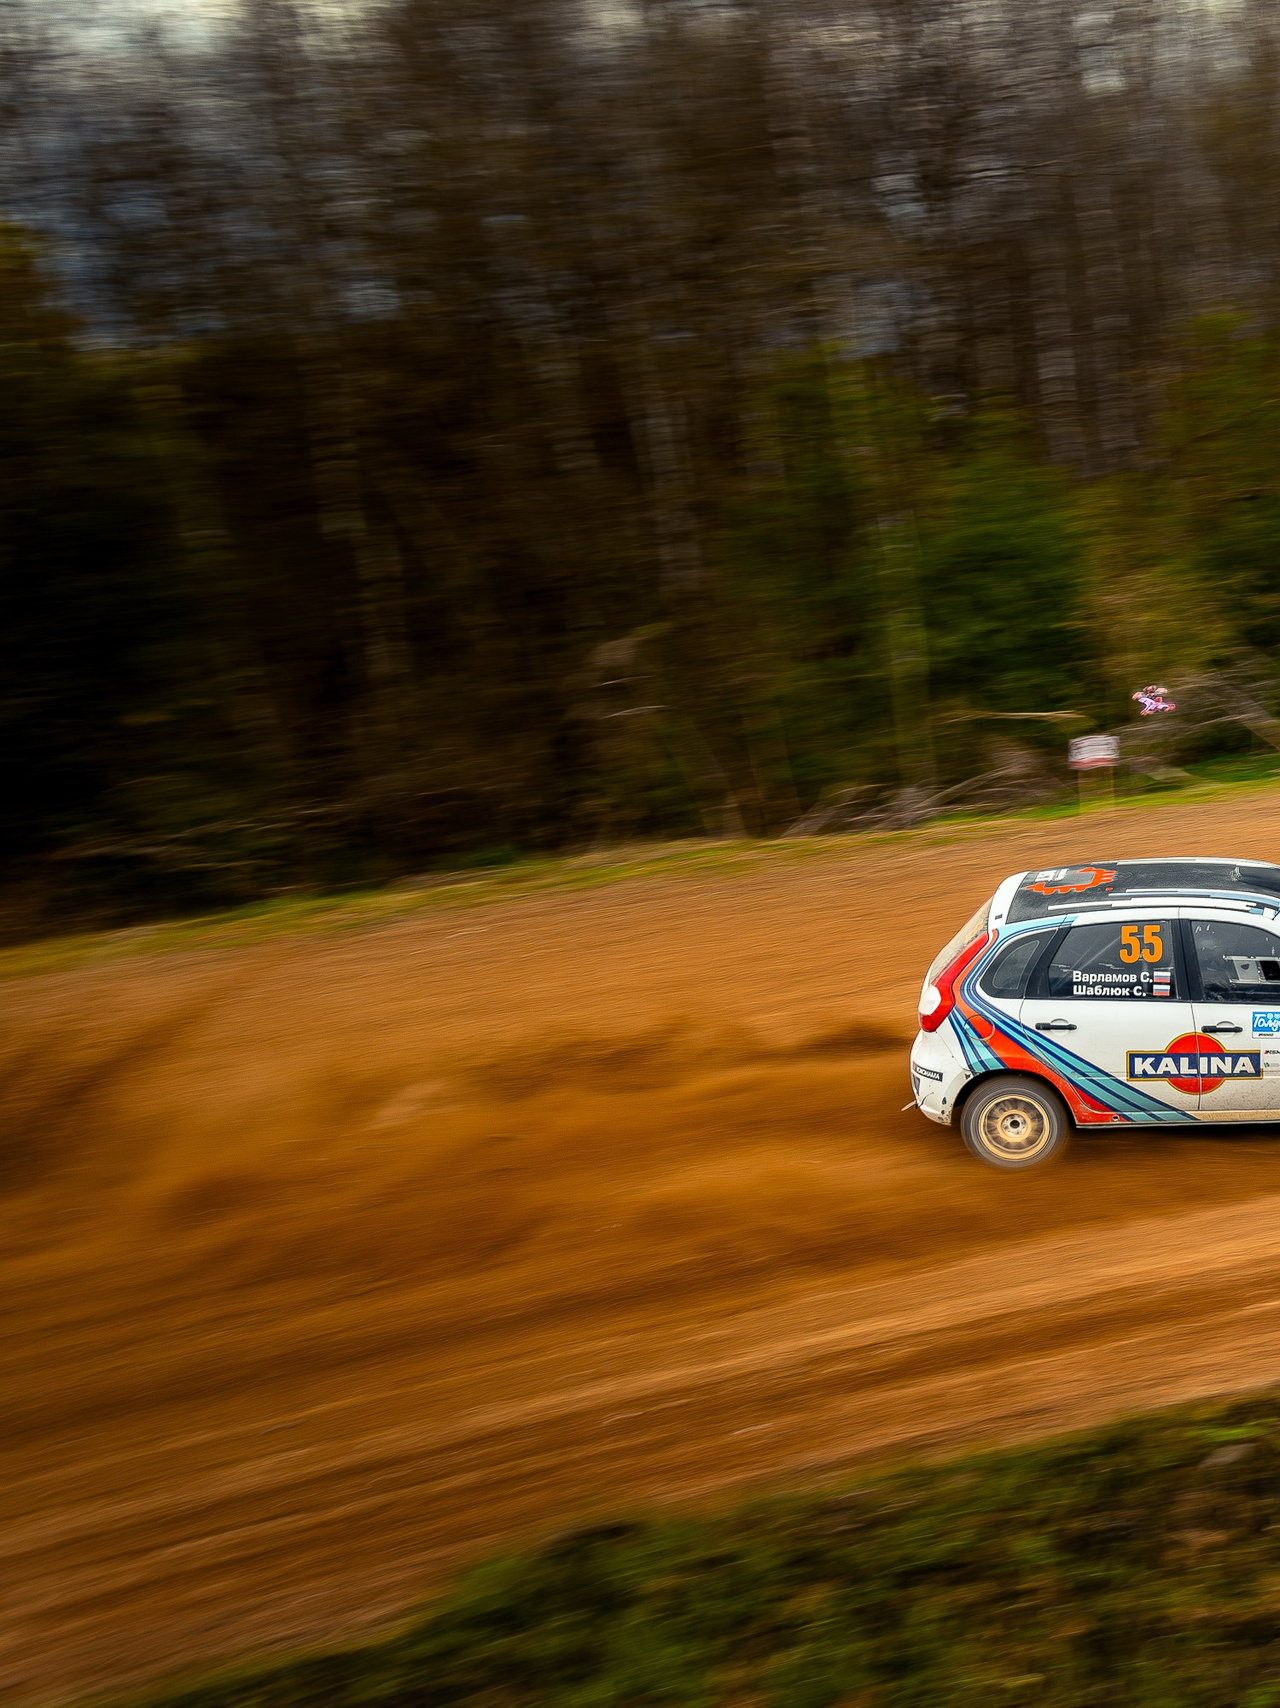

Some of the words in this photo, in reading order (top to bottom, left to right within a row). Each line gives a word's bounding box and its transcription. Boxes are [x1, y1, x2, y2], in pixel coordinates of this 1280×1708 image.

[1119, 924, 1163, 964] 55
[1072, 970, 1138, 985] Варламов
[1140, 971, 1153, 983] С.
[1072, 985, 1130, 997] Шаблюк
[1133, 986, 1147, 997] С.
[1134, 1056, 1256, 1075] KALINA
